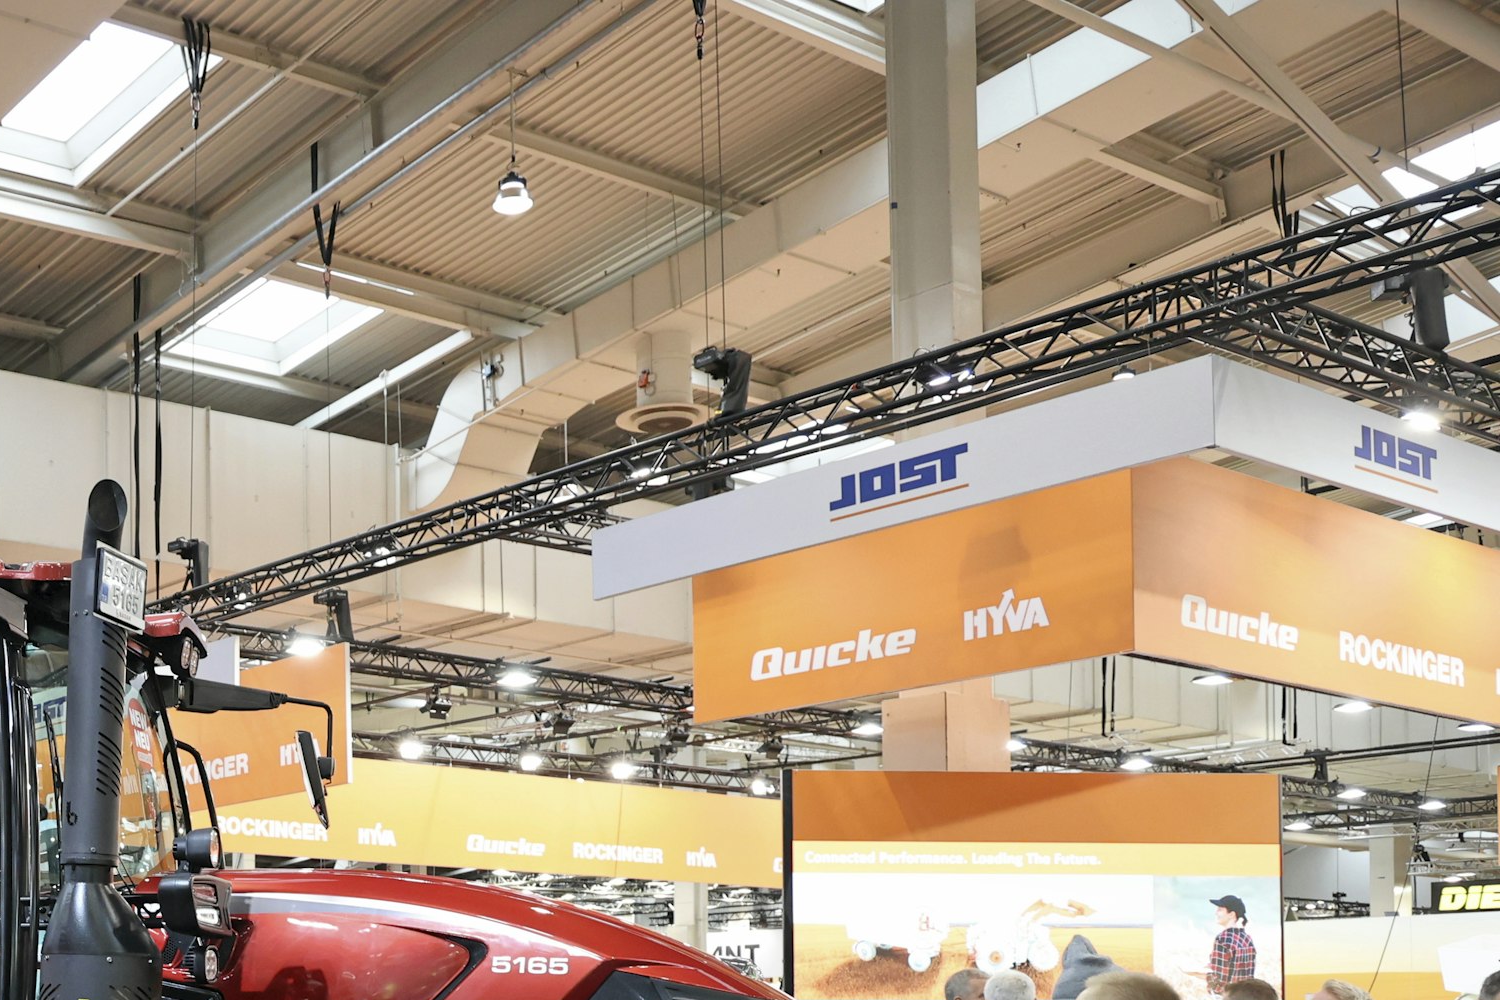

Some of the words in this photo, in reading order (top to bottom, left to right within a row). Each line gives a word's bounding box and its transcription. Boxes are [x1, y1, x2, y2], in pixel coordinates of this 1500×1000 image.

[829, 442, 969, 512] JOST
[1354, 425, 1438, 481] JOST
[103, 553, 144, 594] BASAK
[111, 584, 140, 616] 5165
[750, 628, 917, 682] Quicke
[963, 588, 1050, 642] HYVA
[1181, 593, 1299, 652] Quicke
[1338, 630, 1465, 688] ROCKINGER
[216, 815, 328, 842] ROCKINGER
[357, 822, 397, 847] HYVA
[466, 833, 546, 857] Quicke
[572, 841, 664, 865] ROCKINGER
[490, 955, 569, 975] 5165
